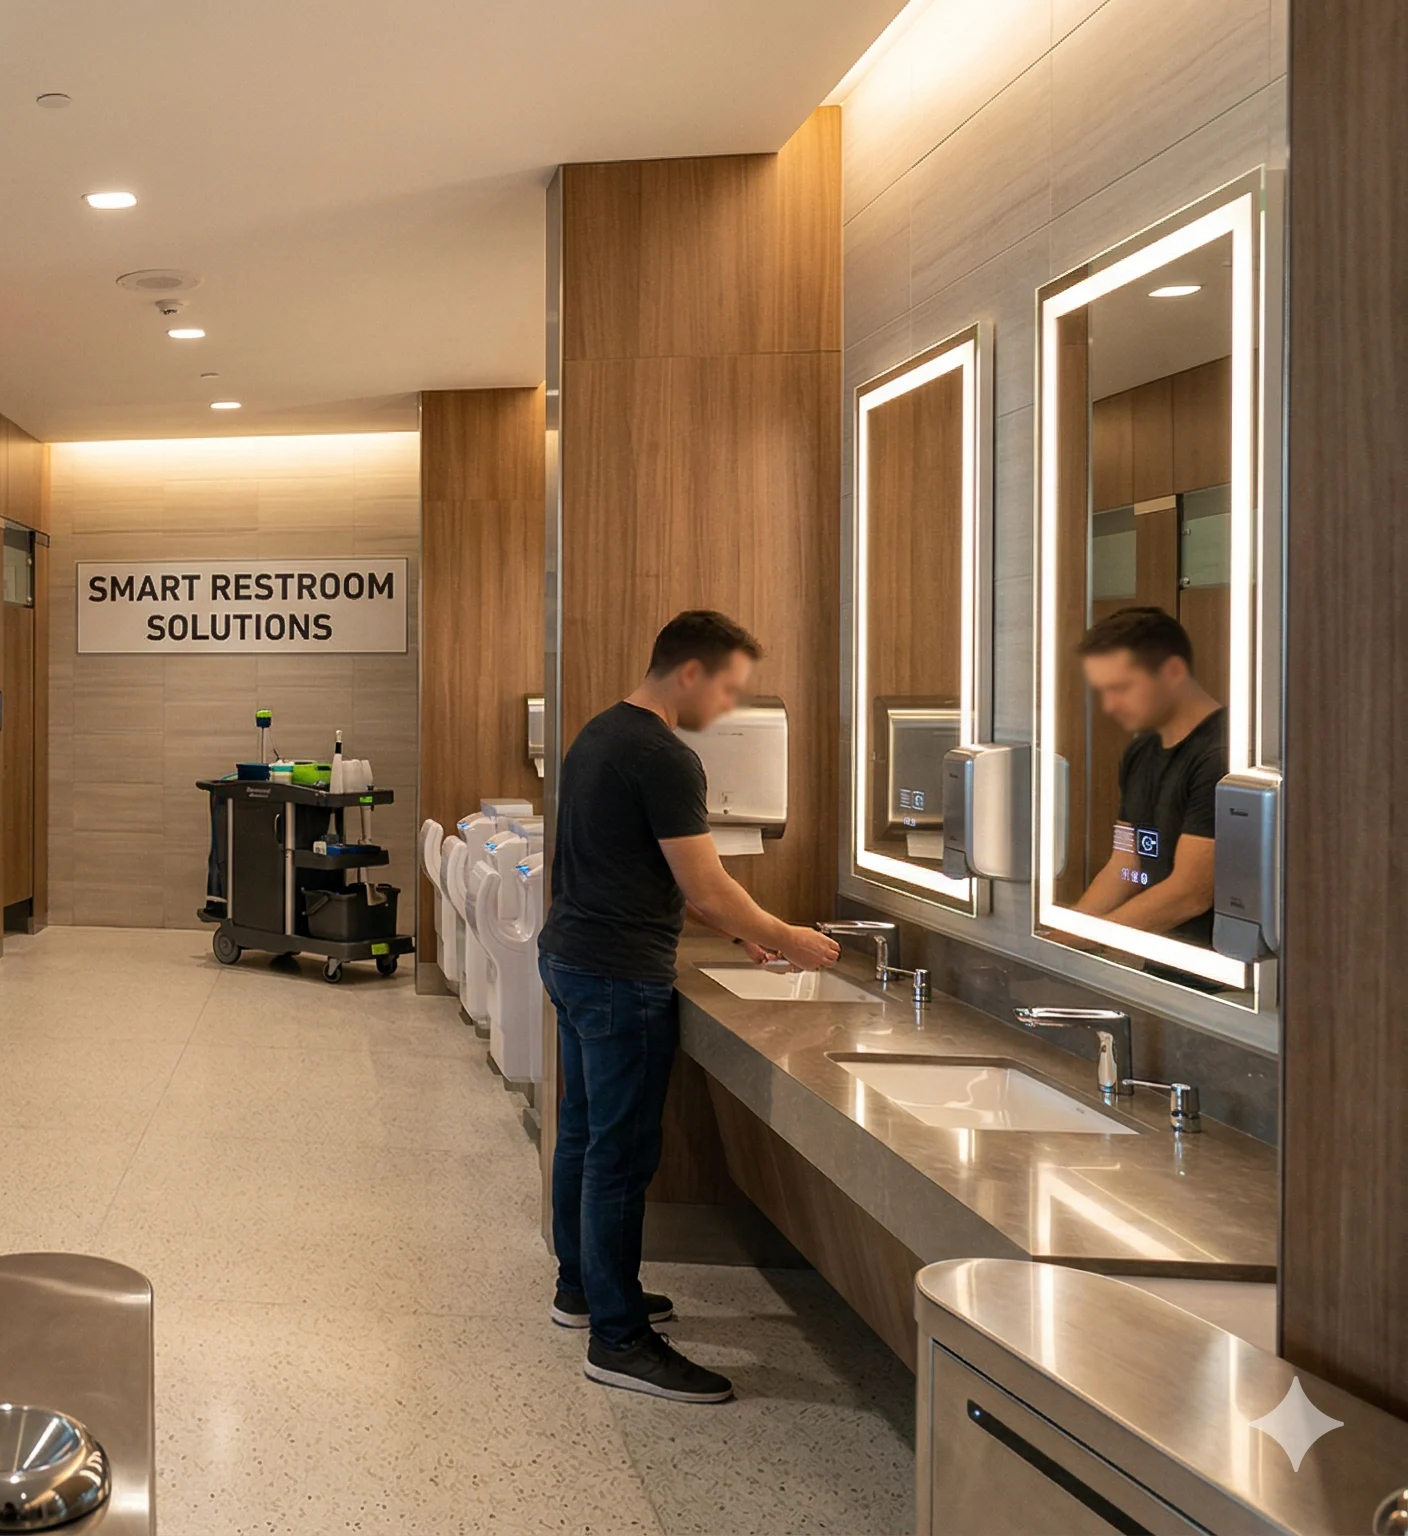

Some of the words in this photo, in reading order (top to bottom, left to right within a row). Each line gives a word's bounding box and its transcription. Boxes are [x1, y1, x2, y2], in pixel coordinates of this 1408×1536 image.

[88, 573, 201, 602] SMART
[211, 572, 394, 601] RESTROOM
[146, 613, 333, 641] SOLUTIONS
